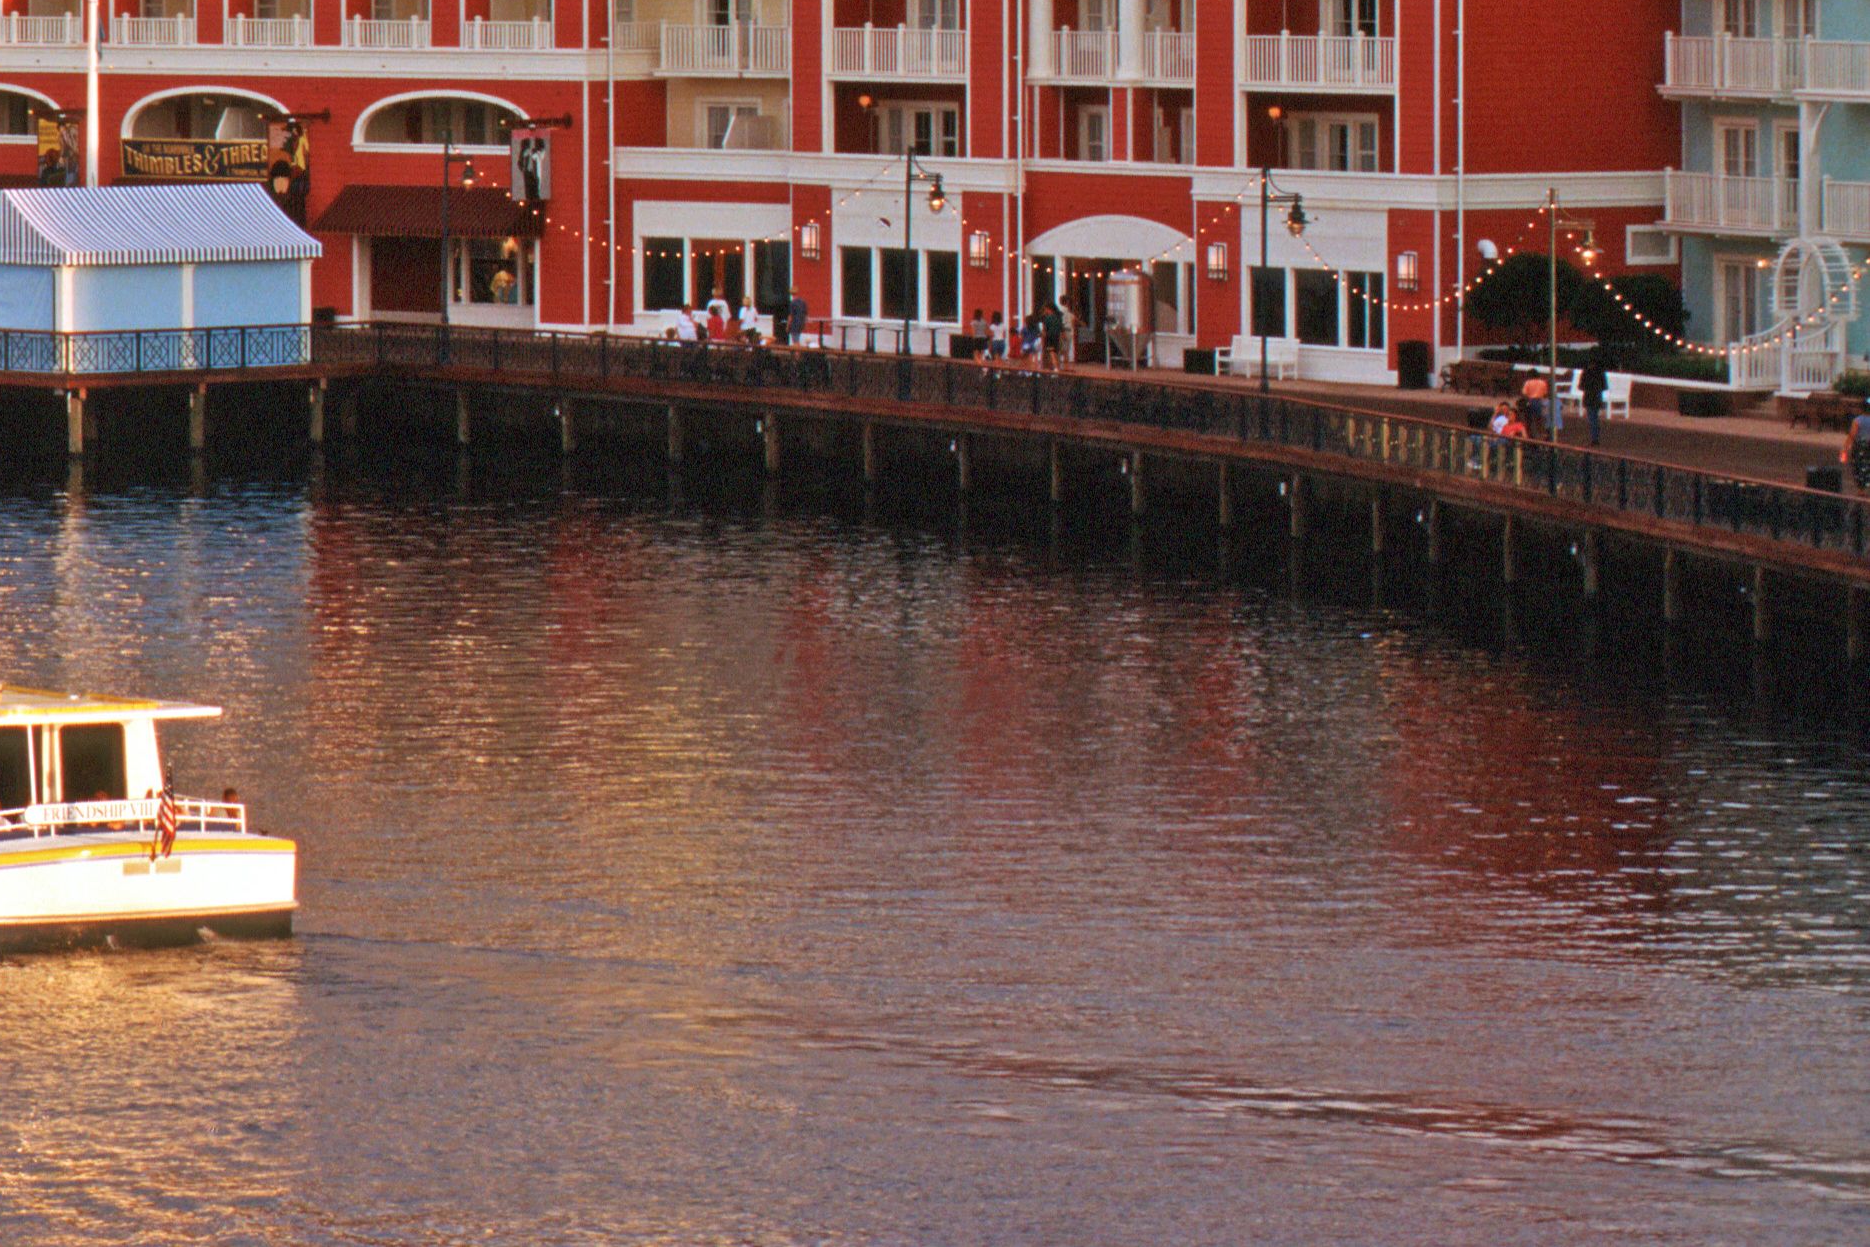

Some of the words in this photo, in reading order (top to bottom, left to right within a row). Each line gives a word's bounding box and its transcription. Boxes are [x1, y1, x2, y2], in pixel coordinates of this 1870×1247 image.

[124, 145, 202, 175] THIMBLES
[203, 144, 220, 175] &
[220, 144, 269, 166] THREA
[43, 803, 127, 821] FRIENDSHIP
